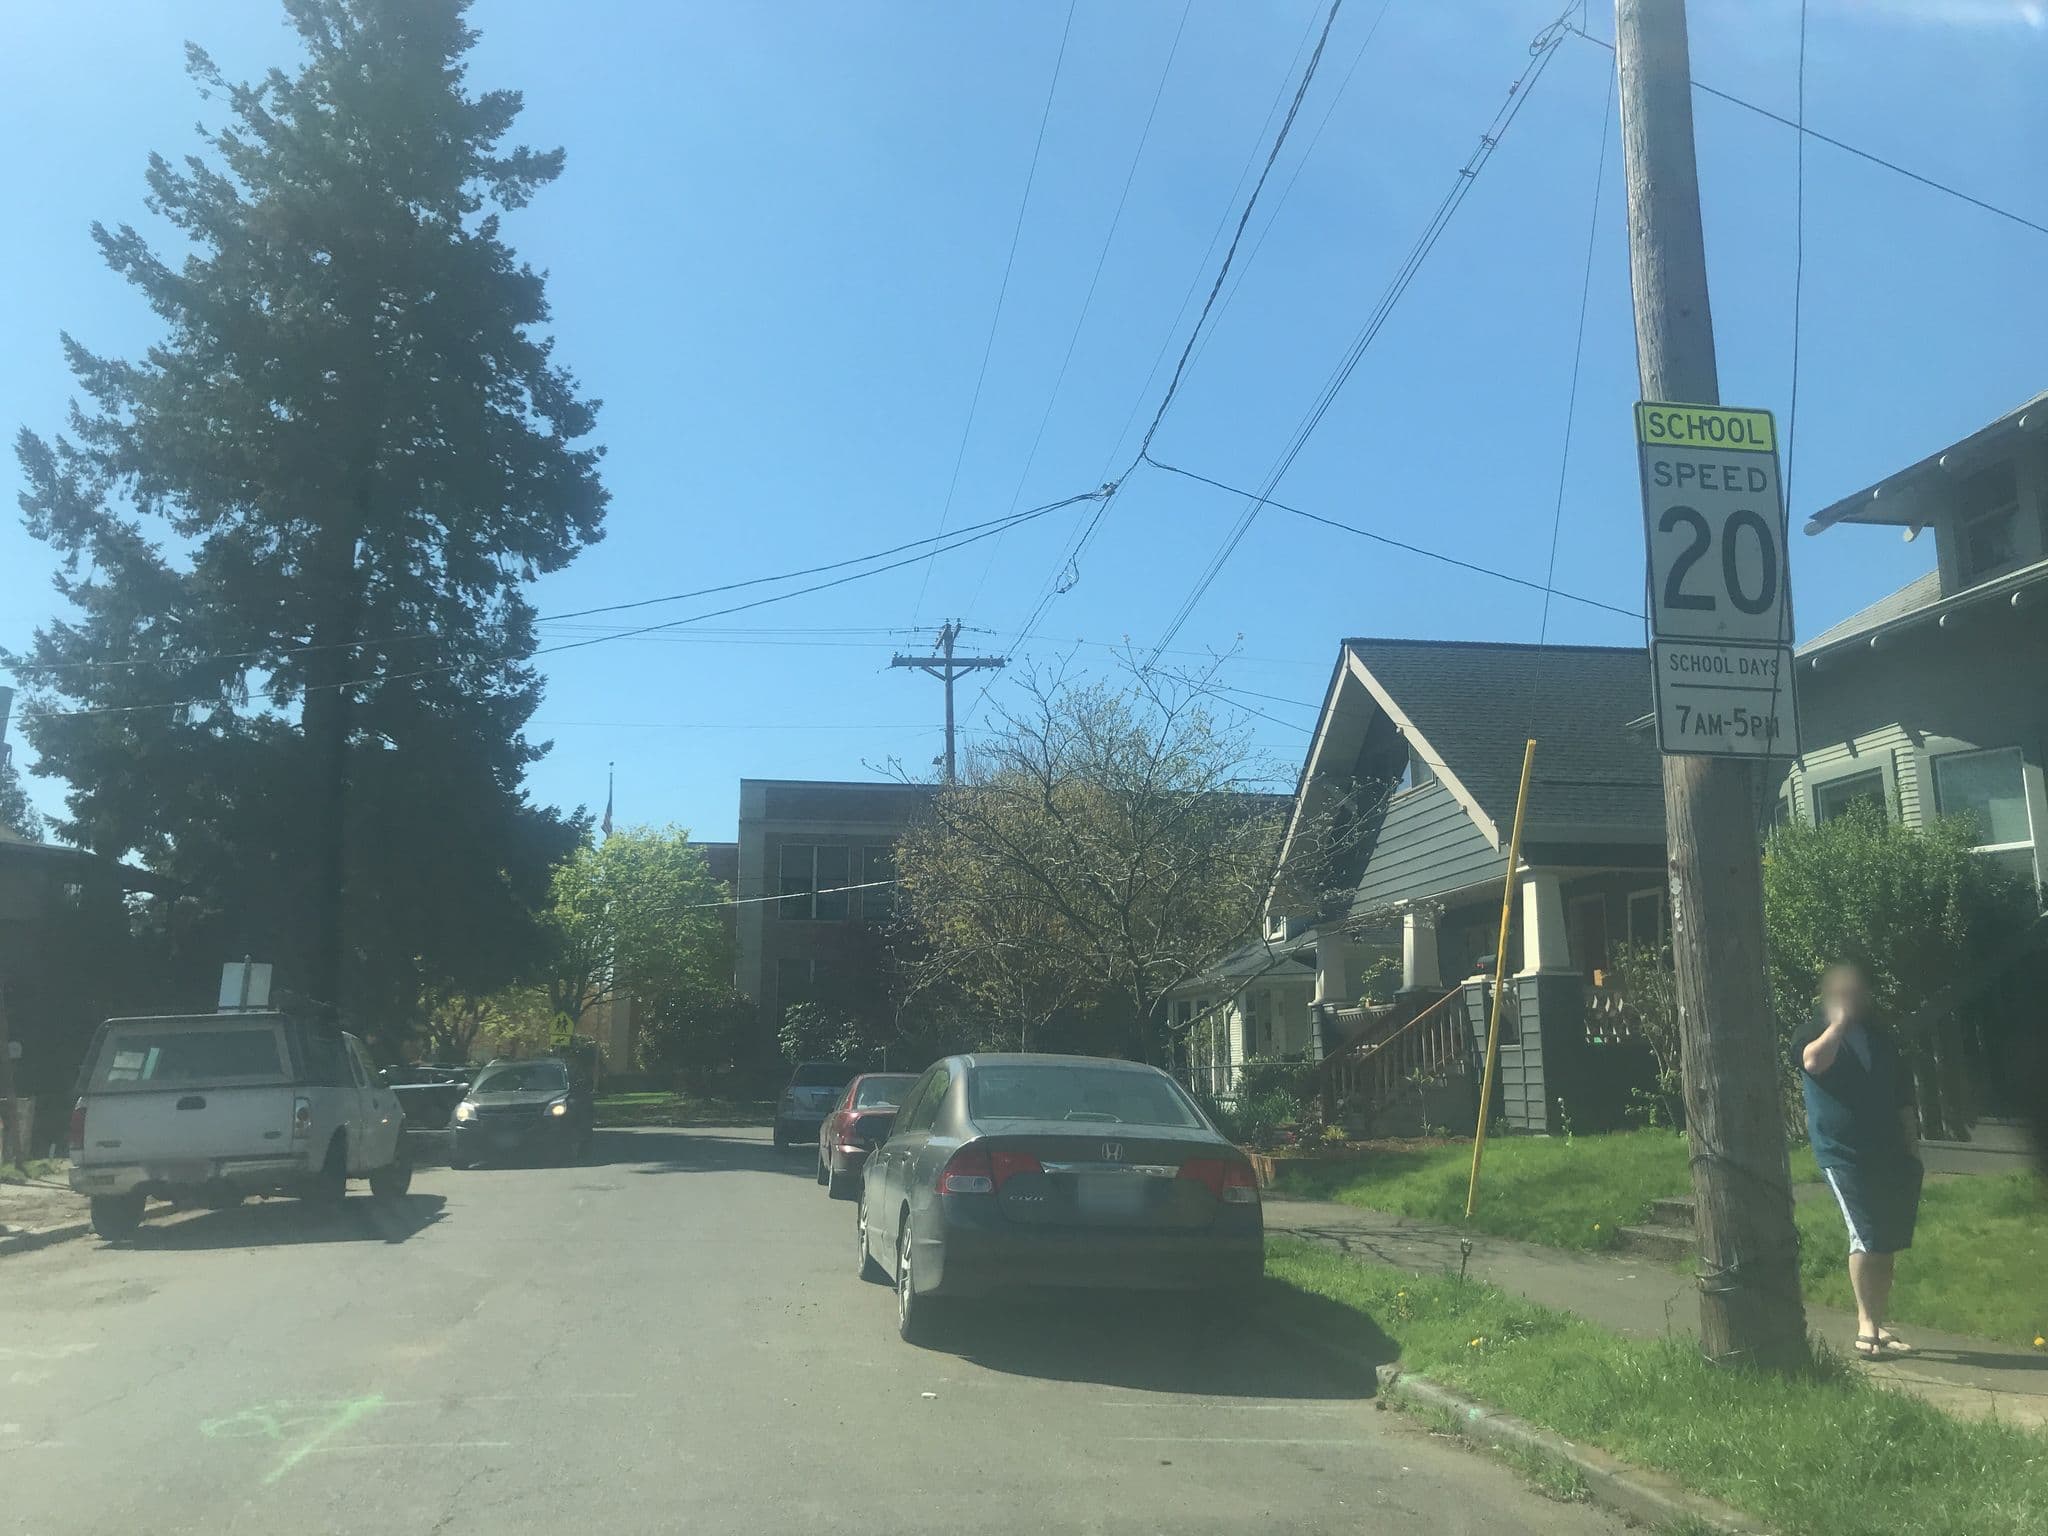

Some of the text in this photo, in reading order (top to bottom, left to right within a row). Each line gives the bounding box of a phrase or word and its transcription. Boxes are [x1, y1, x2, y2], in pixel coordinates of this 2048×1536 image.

[1648, 411, 1764, 444] SCHOOL
[1653, 461, 1768, 493] SPEED
[1658, 505, 1777, 615] 20
[1669, 653, 1778, 676] SCHOOL DAYS
